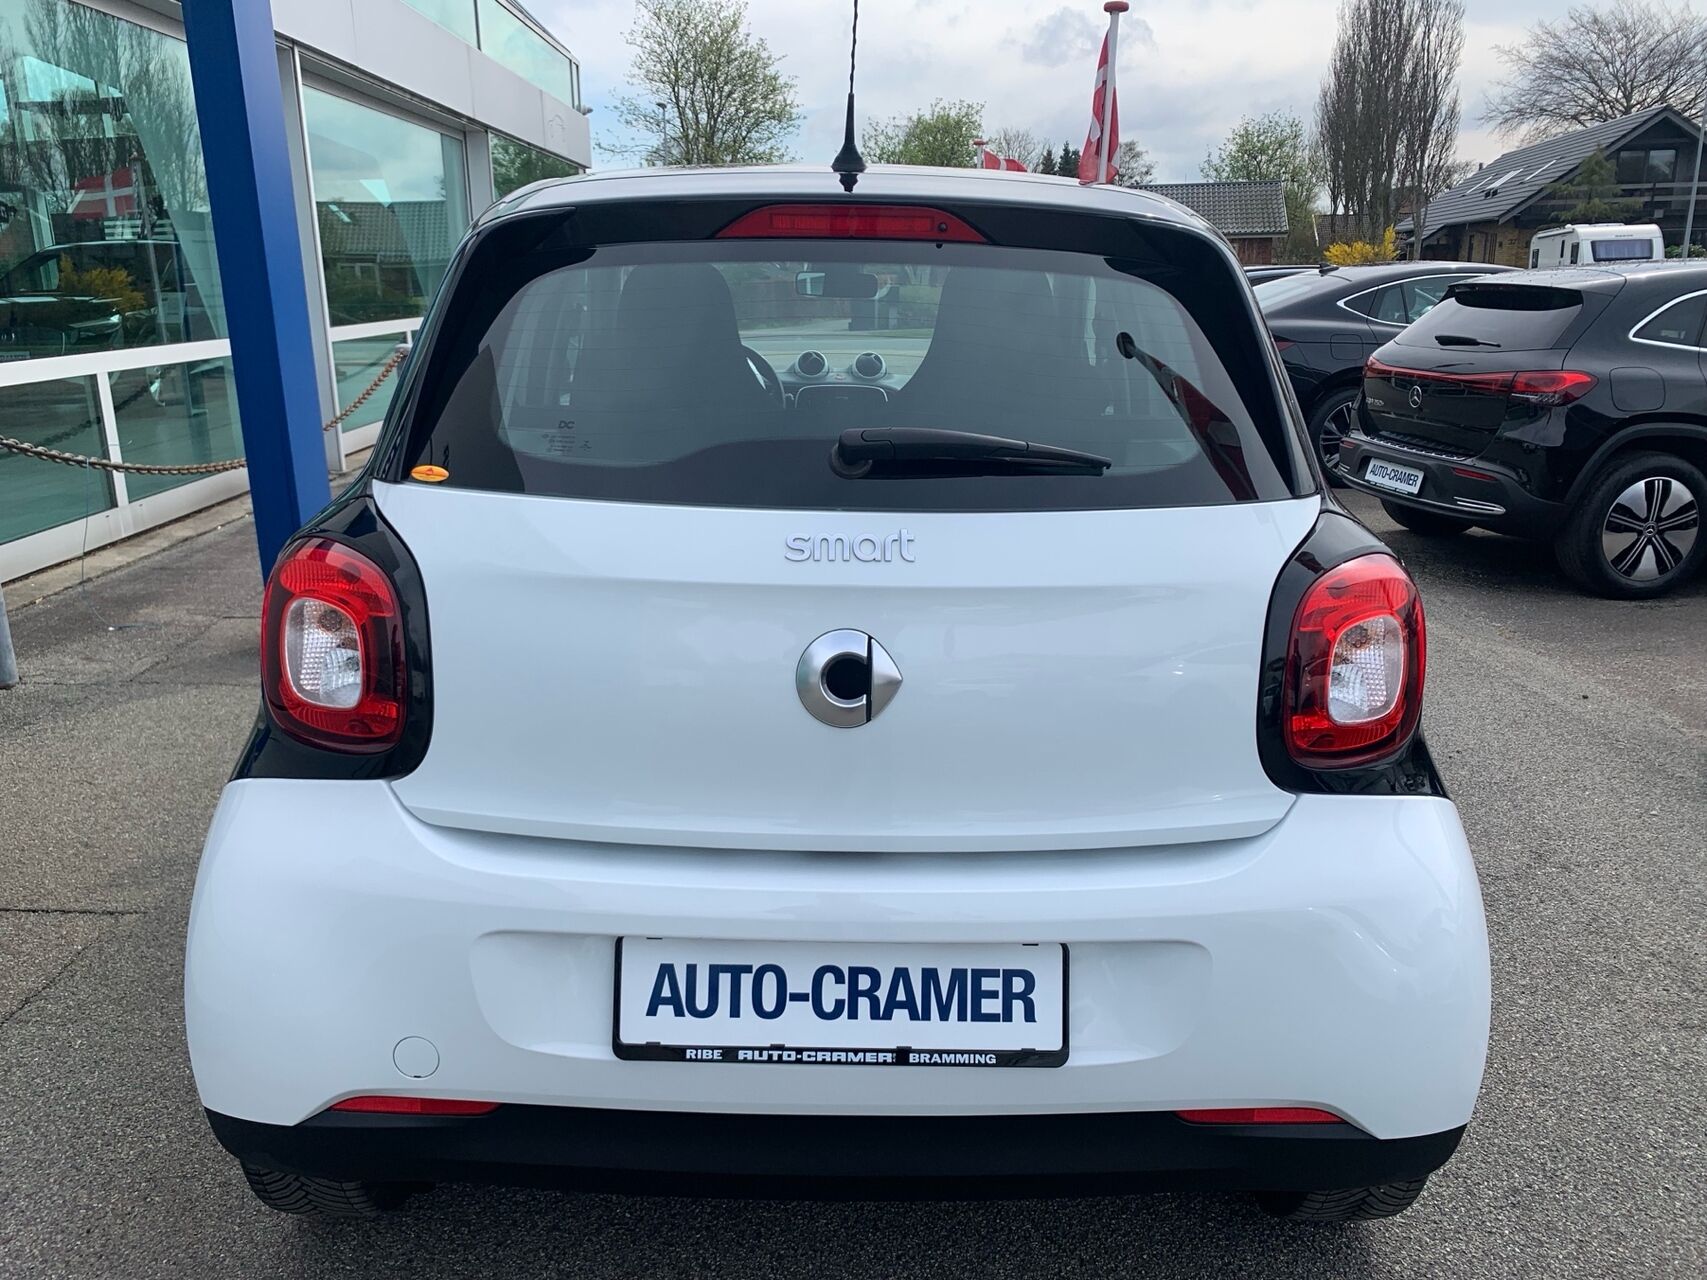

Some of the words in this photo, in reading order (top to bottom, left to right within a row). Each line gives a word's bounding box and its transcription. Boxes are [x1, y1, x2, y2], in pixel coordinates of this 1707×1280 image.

[1370, 464, 1419, 487] AUTO-CRAMER
[784, 529, 916, 562] smart
[645, 963, 1037, 1023] AUTO-CRAMER
[685, 1049, 723, 1060] RIBE
[737, 1049, 893, 1063] AUTO-CRAMER
[908, 1053, 997, 1064] BRAMMING
